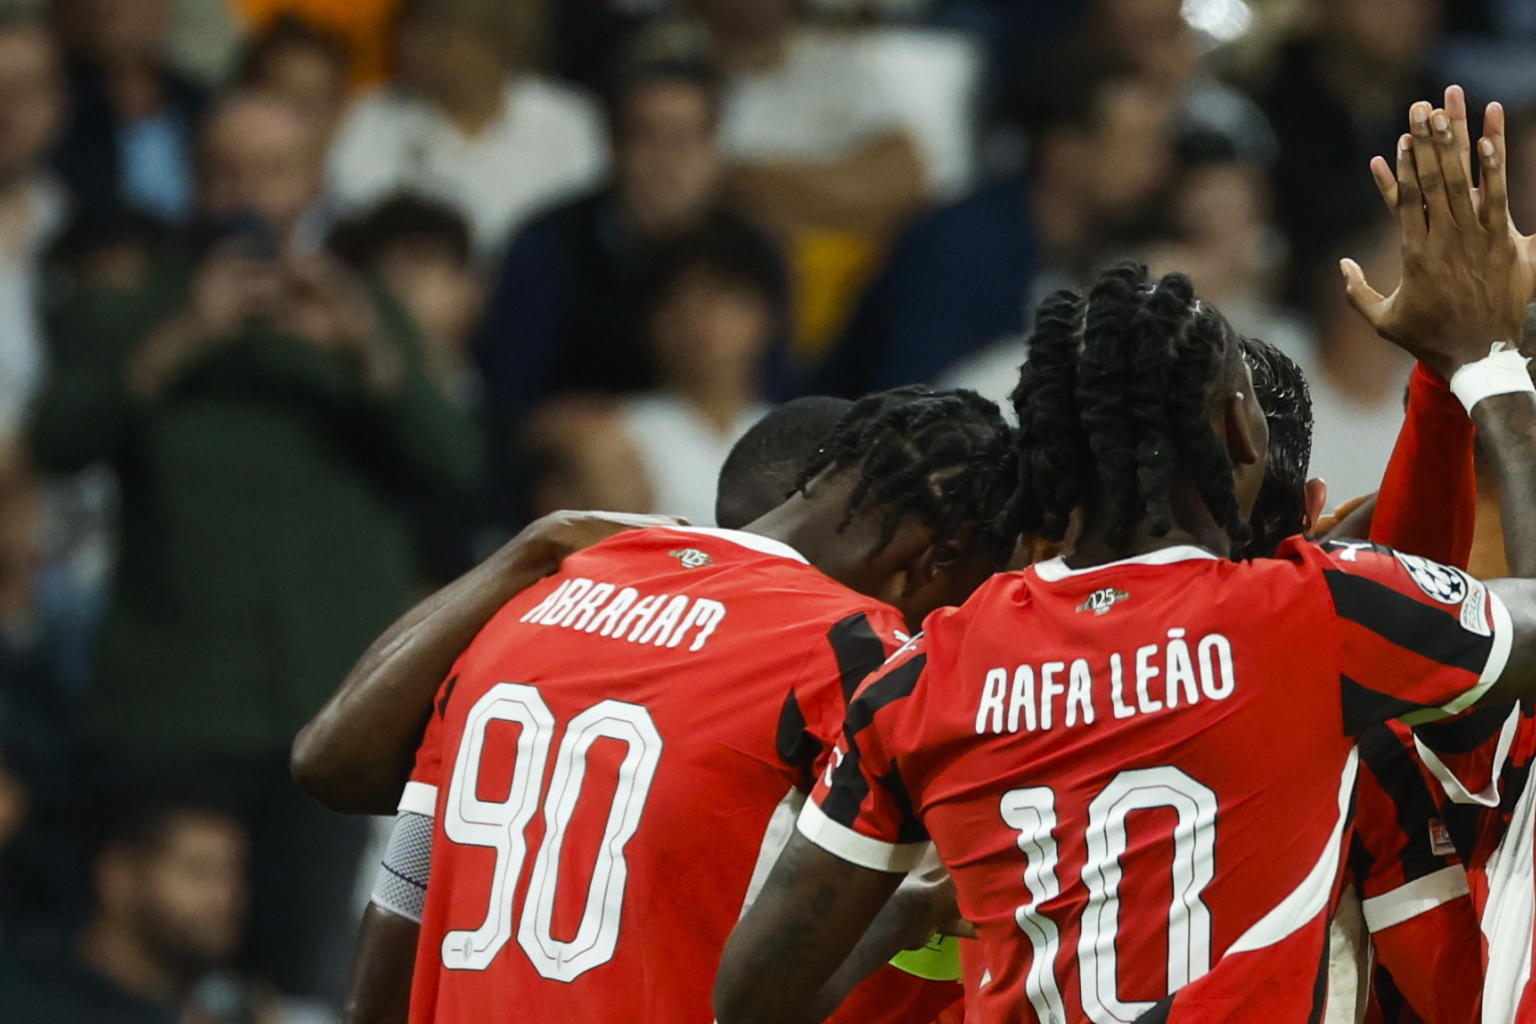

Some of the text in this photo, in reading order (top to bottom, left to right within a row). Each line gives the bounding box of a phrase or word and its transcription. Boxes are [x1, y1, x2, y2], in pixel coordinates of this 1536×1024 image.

[519, 577, 726, 651] ABRAHAM
[1090, 587, 1115, 609] 125
[975, 627, 1235, 734] RAFA LEÃO
[441, 682, 664, 984] 90
